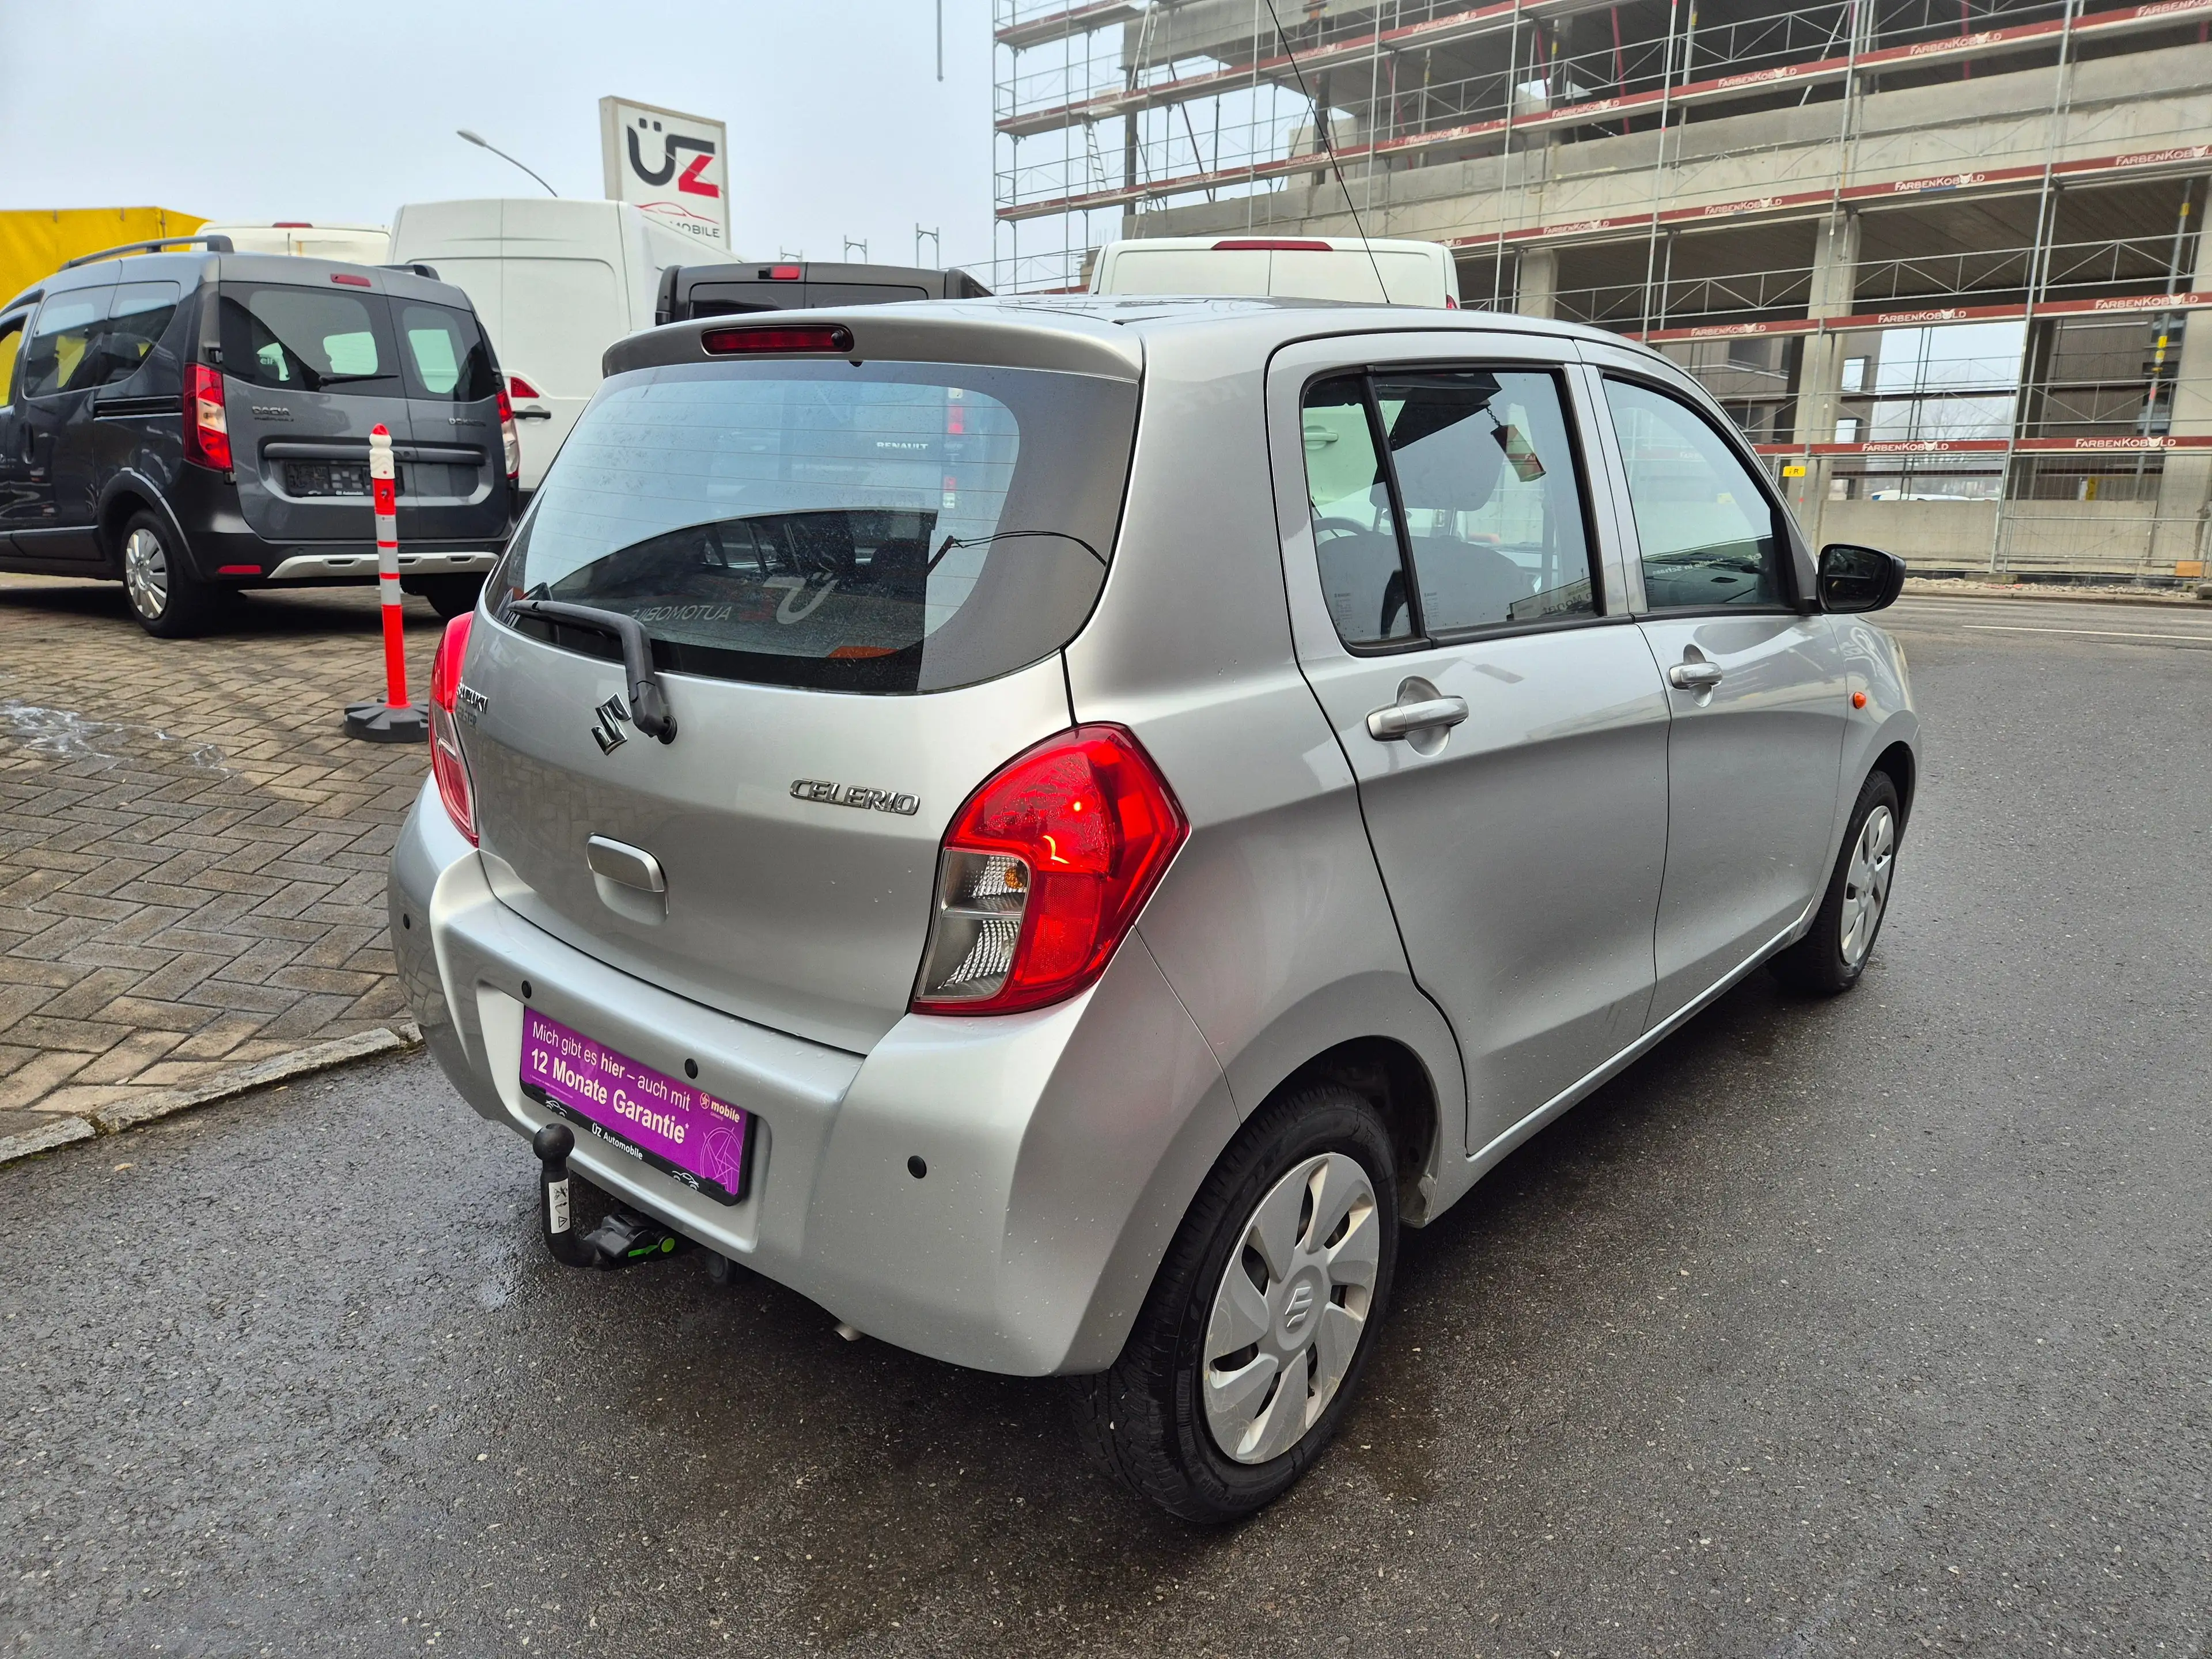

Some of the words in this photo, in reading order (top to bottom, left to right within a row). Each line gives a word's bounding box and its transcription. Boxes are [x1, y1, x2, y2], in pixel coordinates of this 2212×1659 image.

[789, 778, 921, 816] CELERIO
[531, 1048, 548, 1075] 12
[552, 1057, 608, 1111] Monate
[532, 1021, 559, 1048] Mich
[561, 1037, 582, 1059] gibt
[584, 1049, 597, 1066] es
[600, 1053, 626, 1079] hier
[637, 1074, 668, 1101] auch
[671, 1090, 691, 1112] mit
[711, 1100, 740, 1123] mobile
[592, 1122, 602, 1138] ÜZ
[603, 1131, 643, 1160] Automobile
